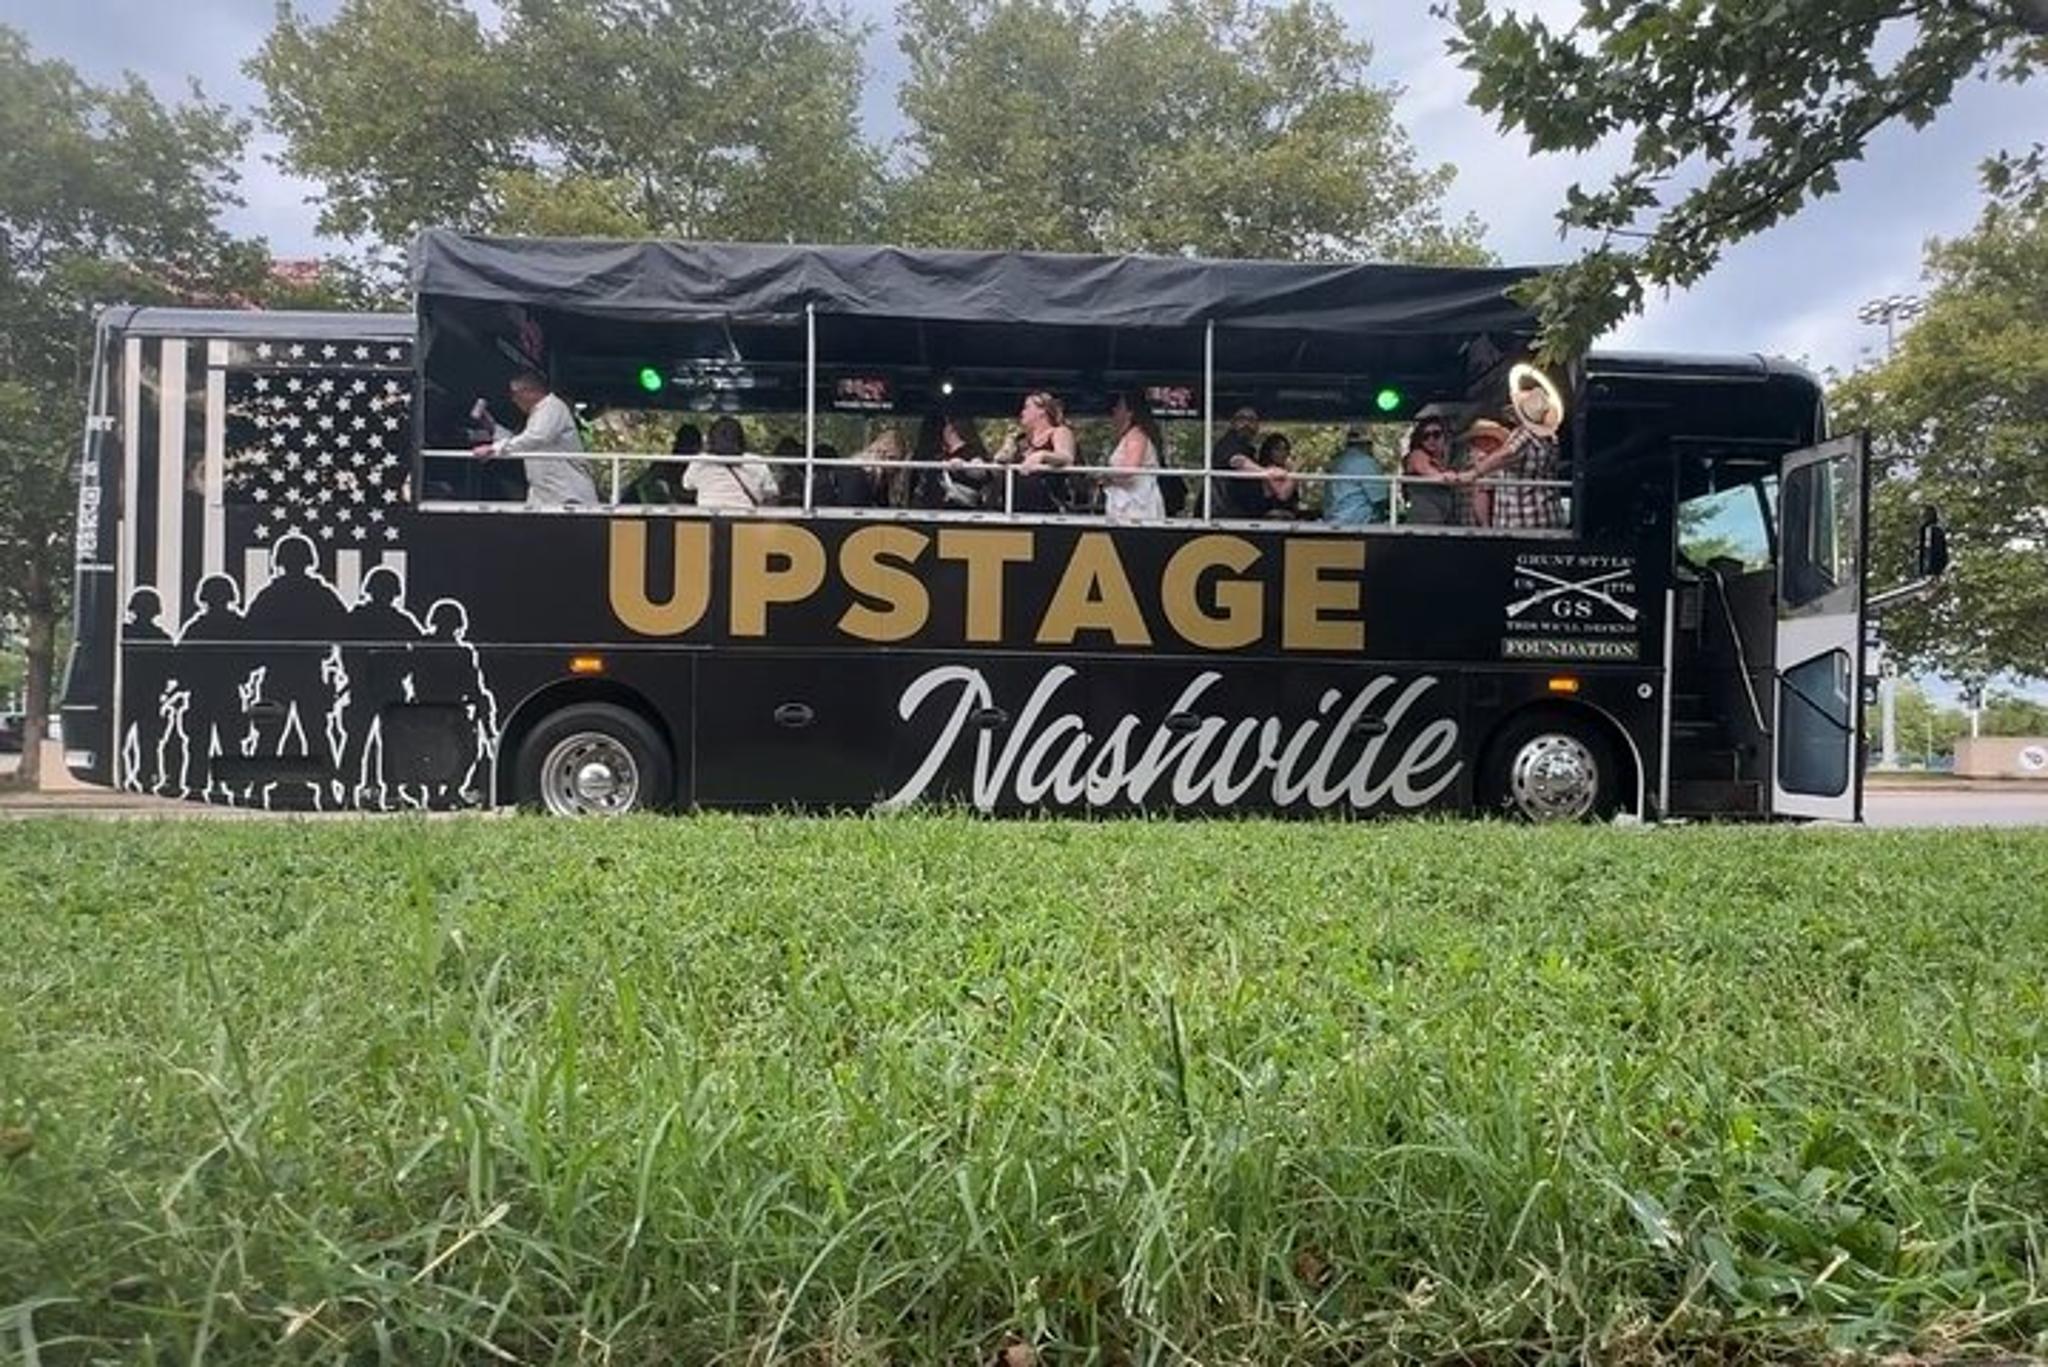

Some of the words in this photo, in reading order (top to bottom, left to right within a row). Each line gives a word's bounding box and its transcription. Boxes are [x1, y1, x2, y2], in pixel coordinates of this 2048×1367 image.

[609, 519, 1366, 651] UPSTAGE
[1552, 599, 1593, 617] GS
[1505, 640, 1635, 657] FOUNDATION
[890, 664, 1464, 812] Nashville
